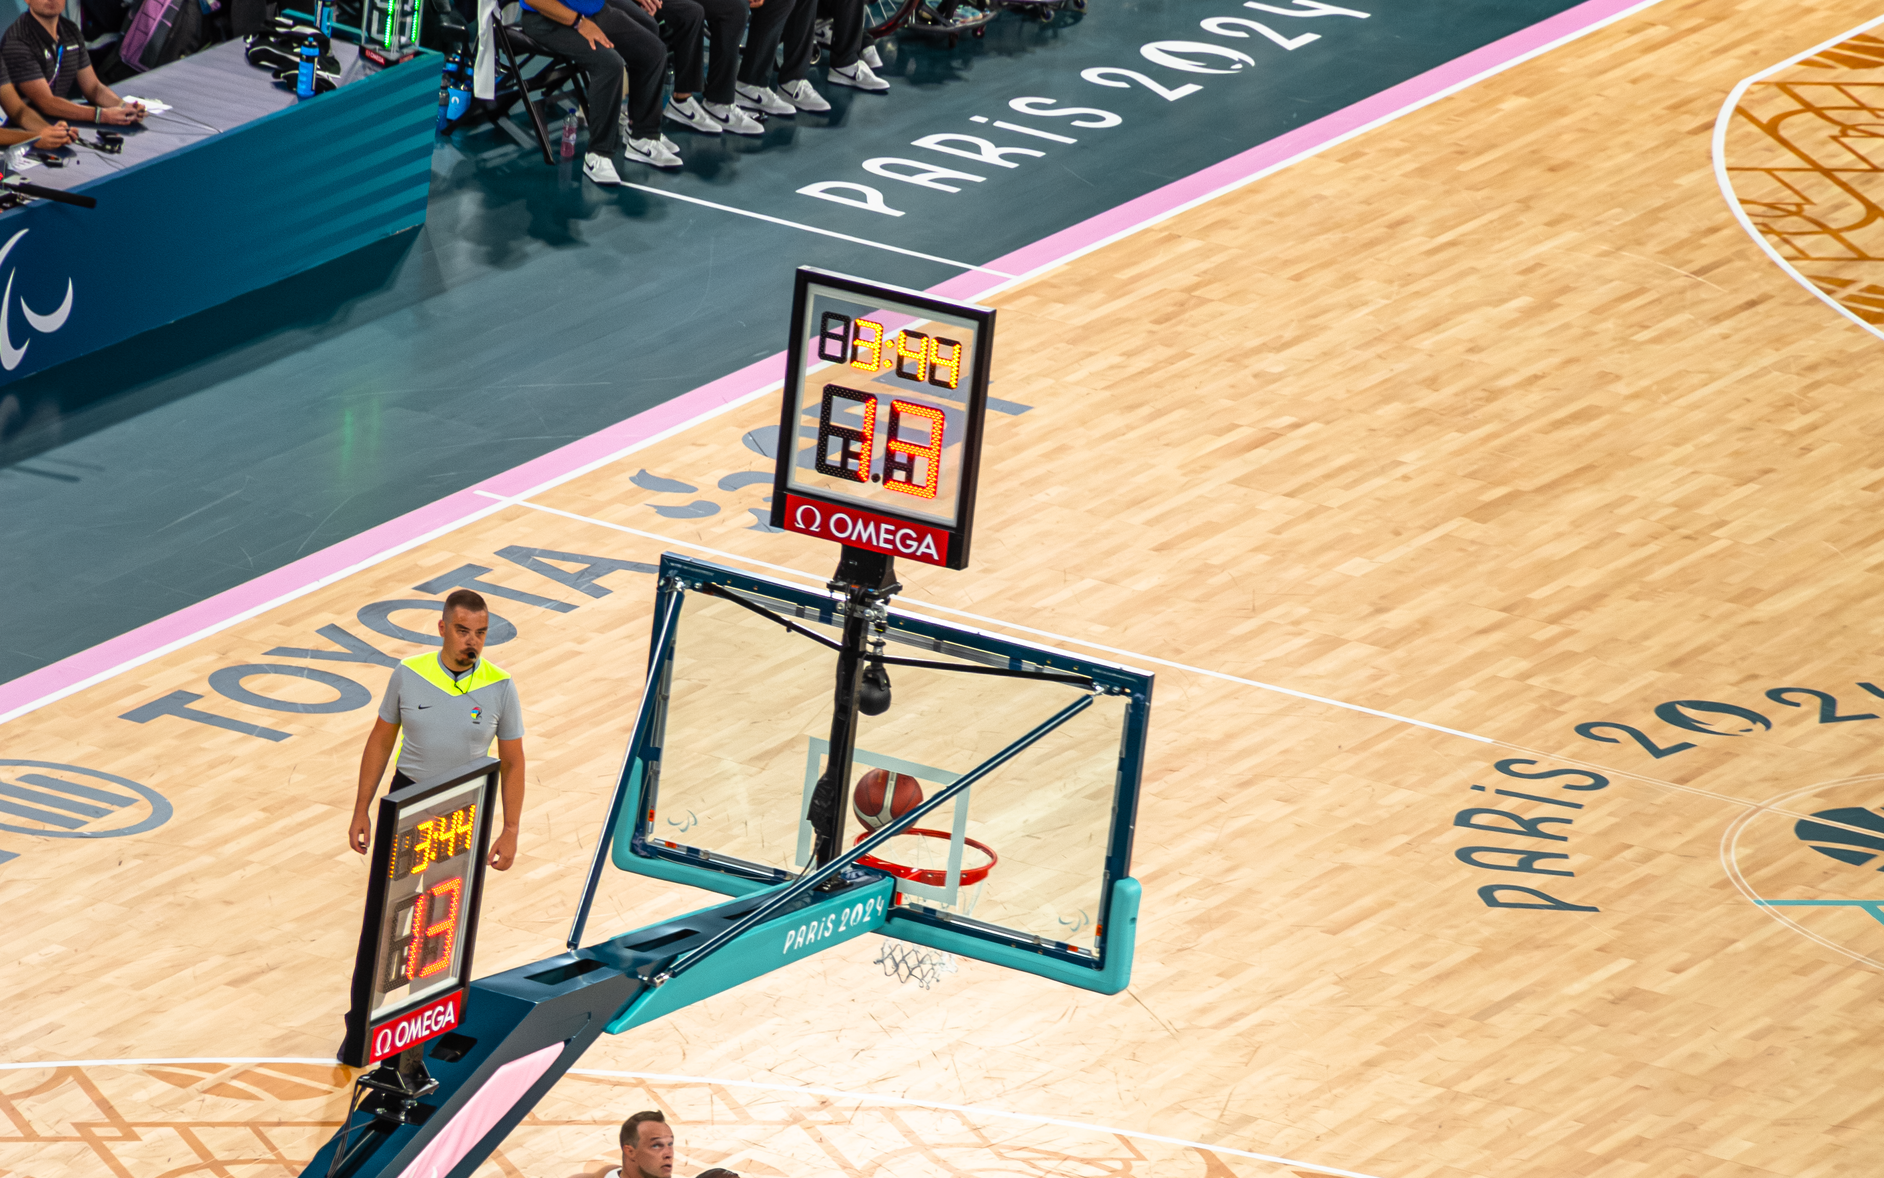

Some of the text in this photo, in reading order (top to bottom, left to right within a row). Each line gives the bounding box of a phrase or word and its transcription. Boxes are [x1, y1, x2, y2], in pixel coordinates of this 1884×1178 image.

[851, 317, 961, 389] 3:44
[829, 513, 939, 561] OMEGA
[117, 545, 659, 743] TOYOTA
[838, 895, 885, 932] 2024
[395, 1000, 455, 1047] OMEGA
